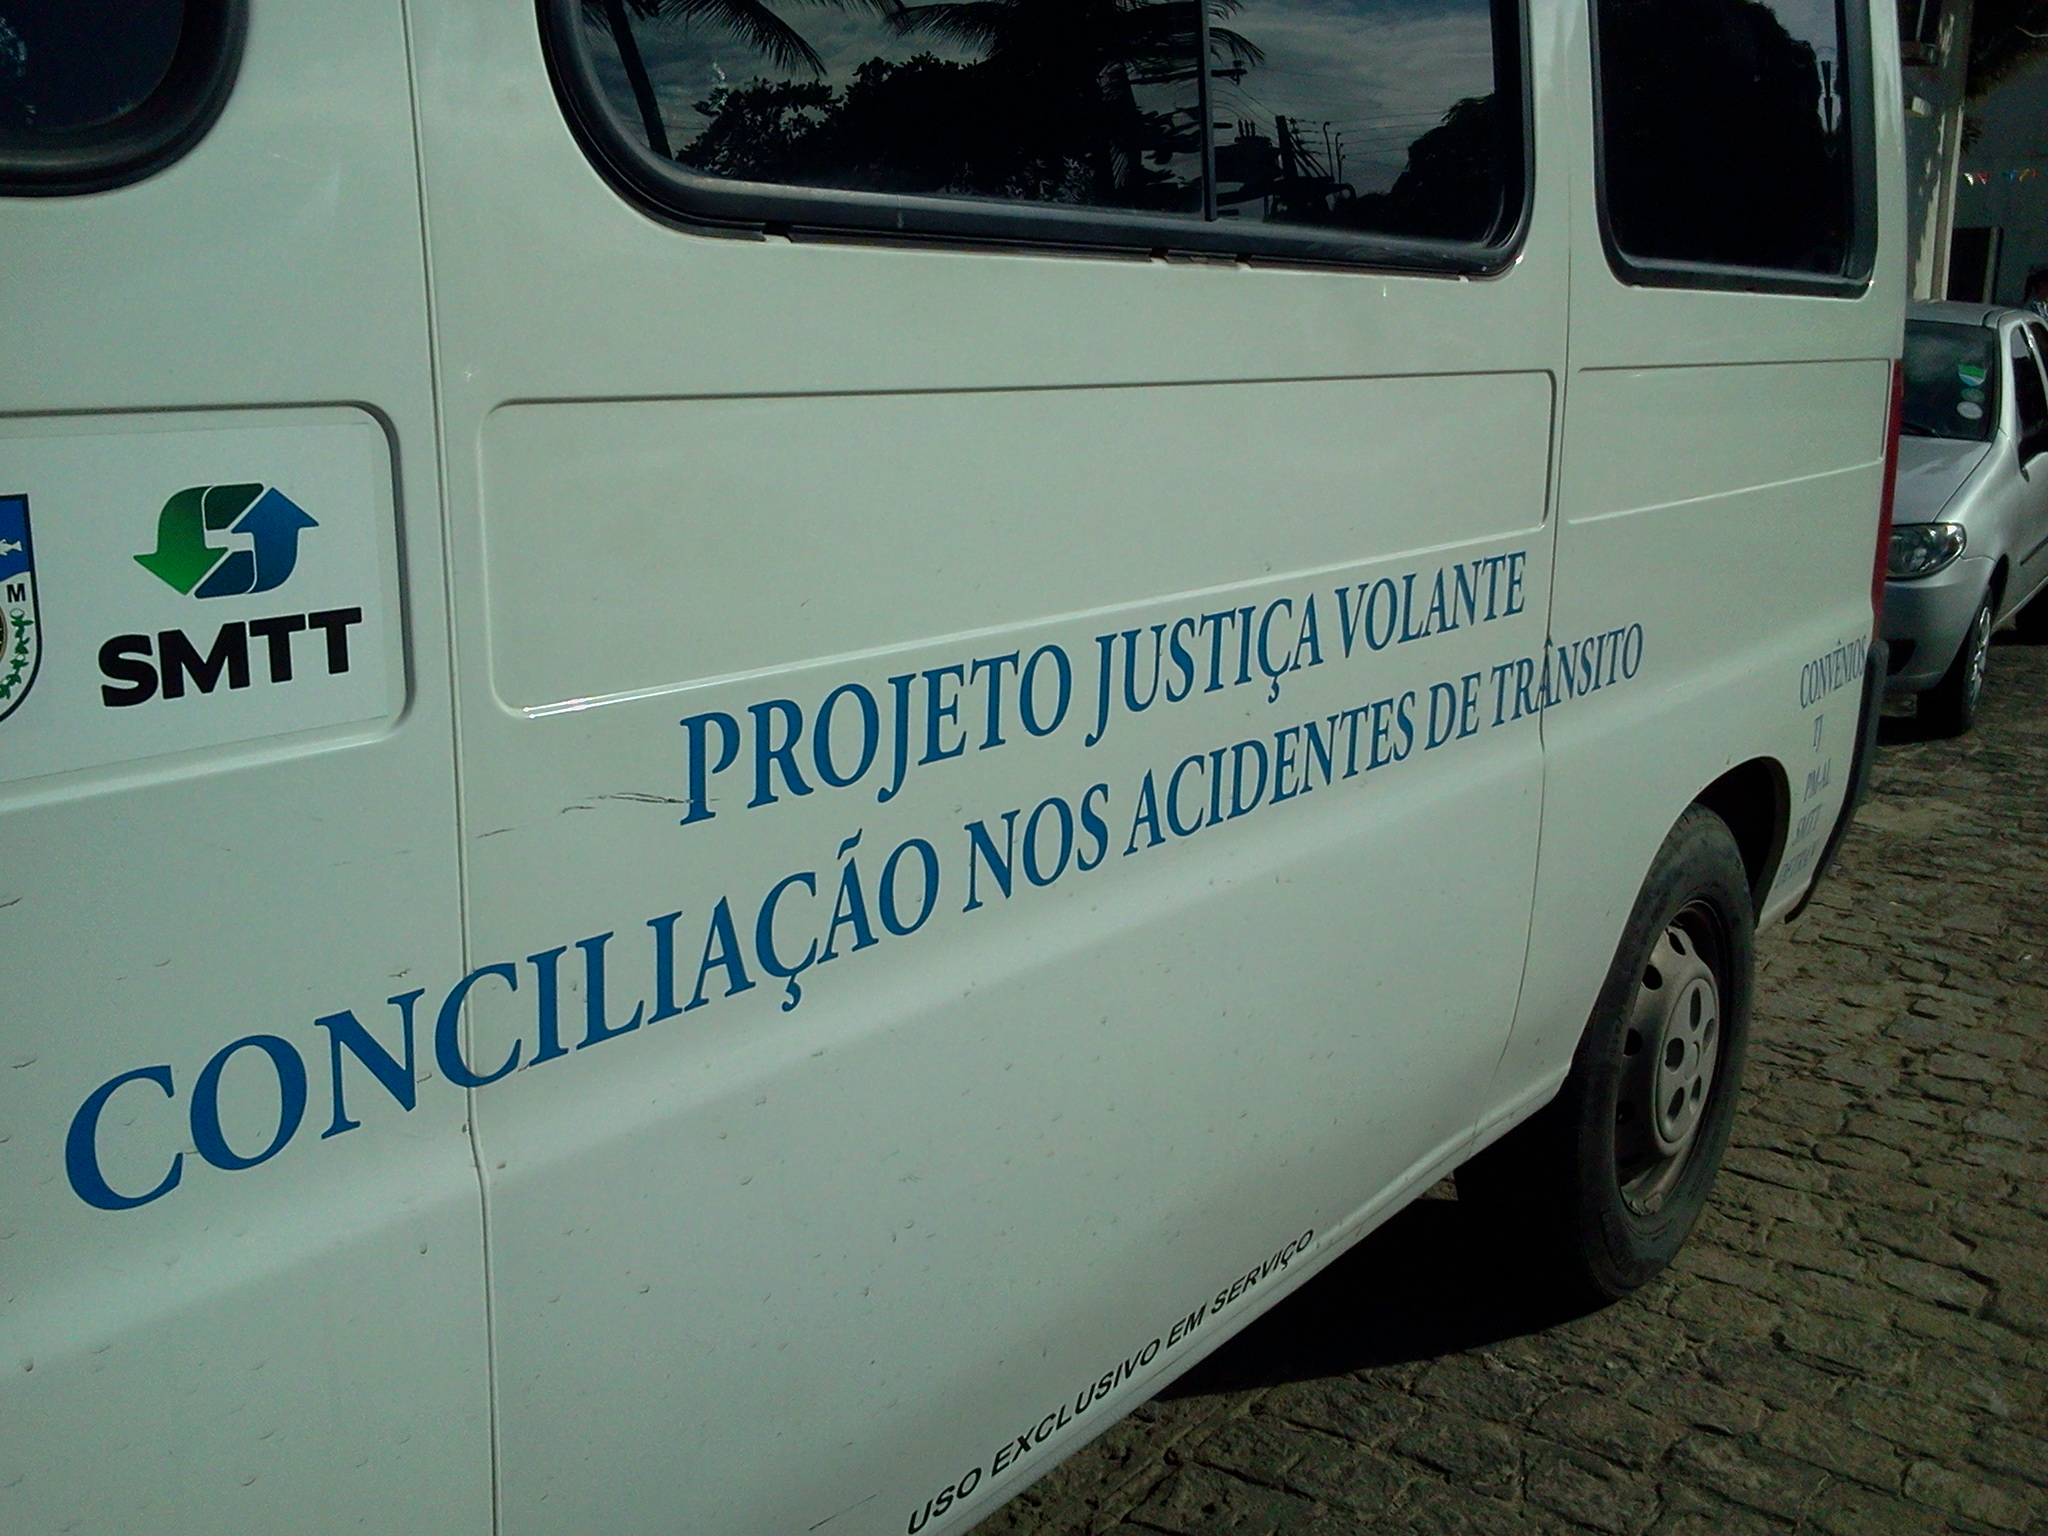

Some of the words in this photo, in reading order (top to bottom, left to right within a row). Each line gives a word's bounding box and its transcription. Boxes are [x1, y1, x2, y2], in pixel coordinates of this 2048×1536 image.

[7, 583, 26, 603] M
[98, 607, 362, 707] SMTT
[1800, 635, 1867, 709] CONVÊNIOS
[680, 645, 1072, 825] PROJETO
[1084, 593, 1324, 747] JUSTIÇA
[1335, 551, 1527, 659] VOLANTE
[65, 828, 940, 1211] CONCILIAÇÃO
[963, 783, 1109, 912] NOS
[1123, 690, 1416, 857] ACIDENTES
[1424, 672, 1482, 751] DE
[1490, 623, 1644, 726] TRÂNSITO
[907, 1467, 983, 1535] USO
[990, 1338, 1161, 1477] EXCLUSIVO
[1166, 1303, 1207, 1349] EM
[1211, 1229, 1315, 1315] SERVIÇO
